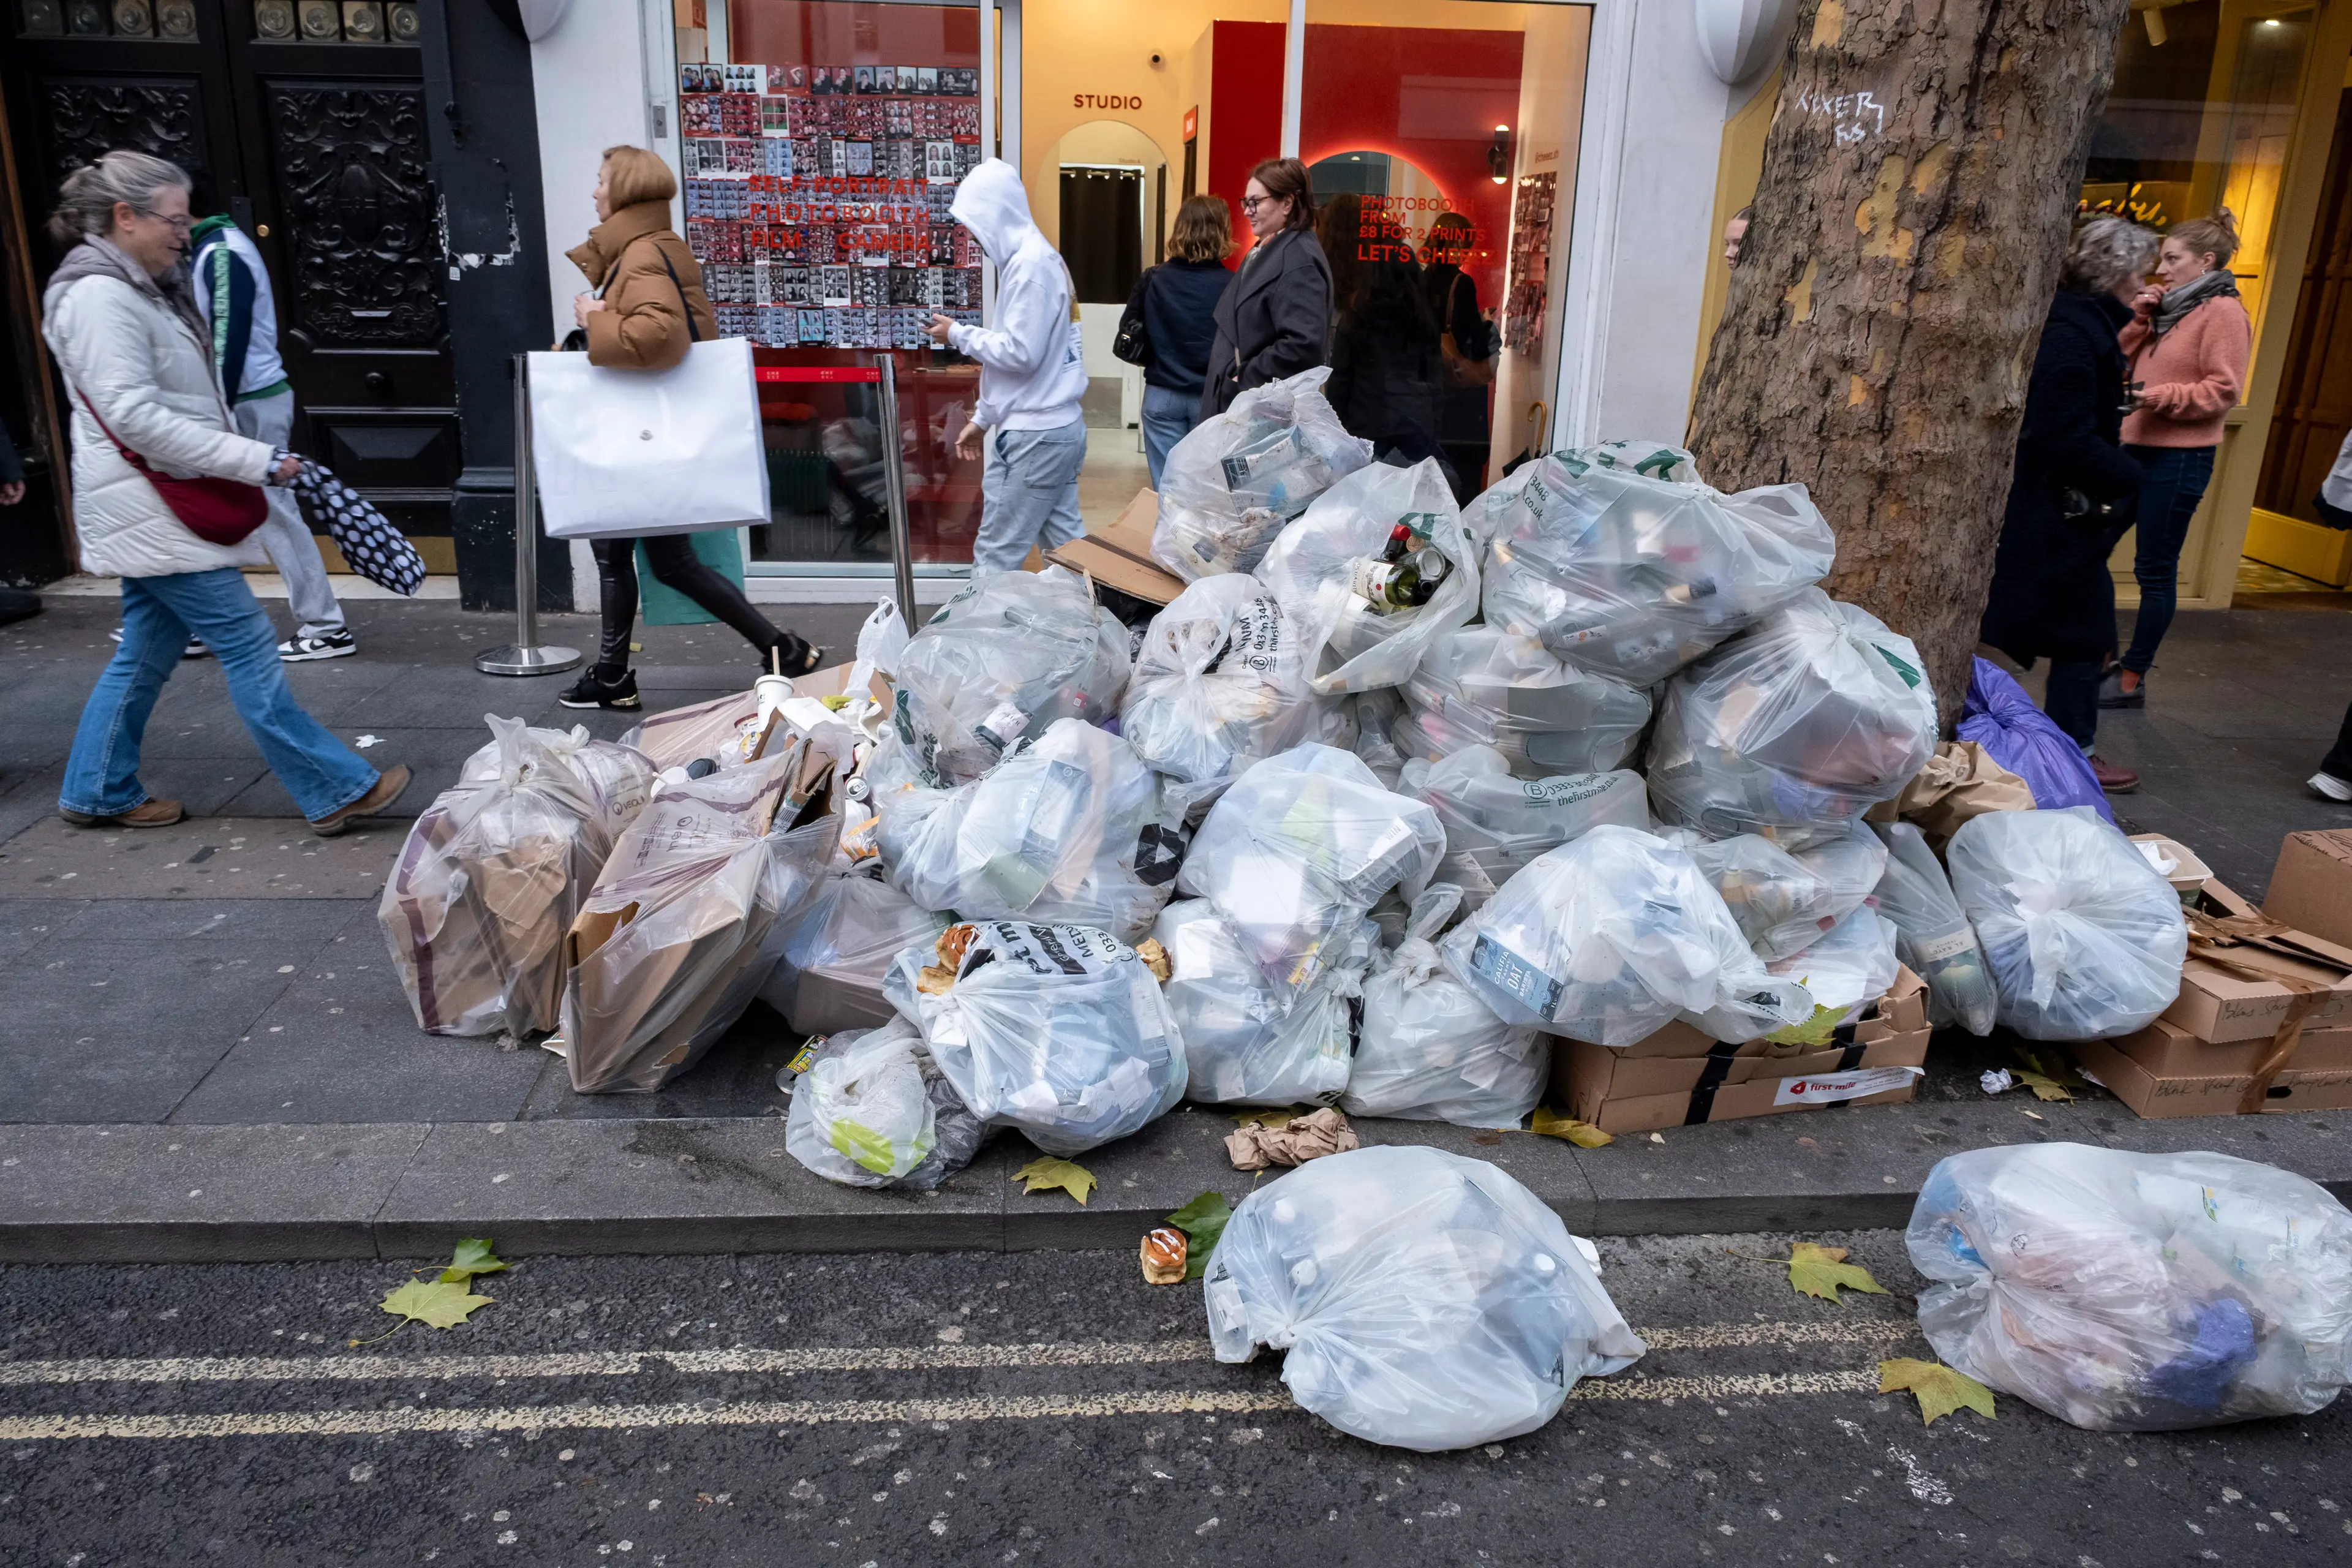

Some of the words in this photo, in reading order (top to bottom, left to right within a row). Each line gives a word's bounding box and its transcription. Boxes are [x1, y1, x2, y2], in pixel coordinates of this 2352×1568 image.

[1074, 94, 1142, 110] STUDIO
[748, 174, 930, 196] SELF-PORTRAIT
[750, 203, 930, 224] PHOTOBOOTH
[1361, 195, 1475, 213] PHOTOBOOTH
[1360, 209, 1406, 225] FROM
[751, 230, 801, 248] FILM
[838, 232, 930, 252] CAMERA
[1359, 225, 1378, 238] £8
[1382, 225, 1413, 239] FOR
[1417, 228, 1426, 240] 2
[1430, 227, 1486, 242] PRINTS
[1357, 244, 1411, 263] LET'S
[1547, 782, 1574, 795] 0333
[1494, 951, 1511, 985] CALIFIA
[1507, 962, 1524, 990] OAT
[1519, 970, 1531, 997] BARISTA
[1810, 1083, 1833, 1091] first
[1835, 1081, 1856, 1090] mile
